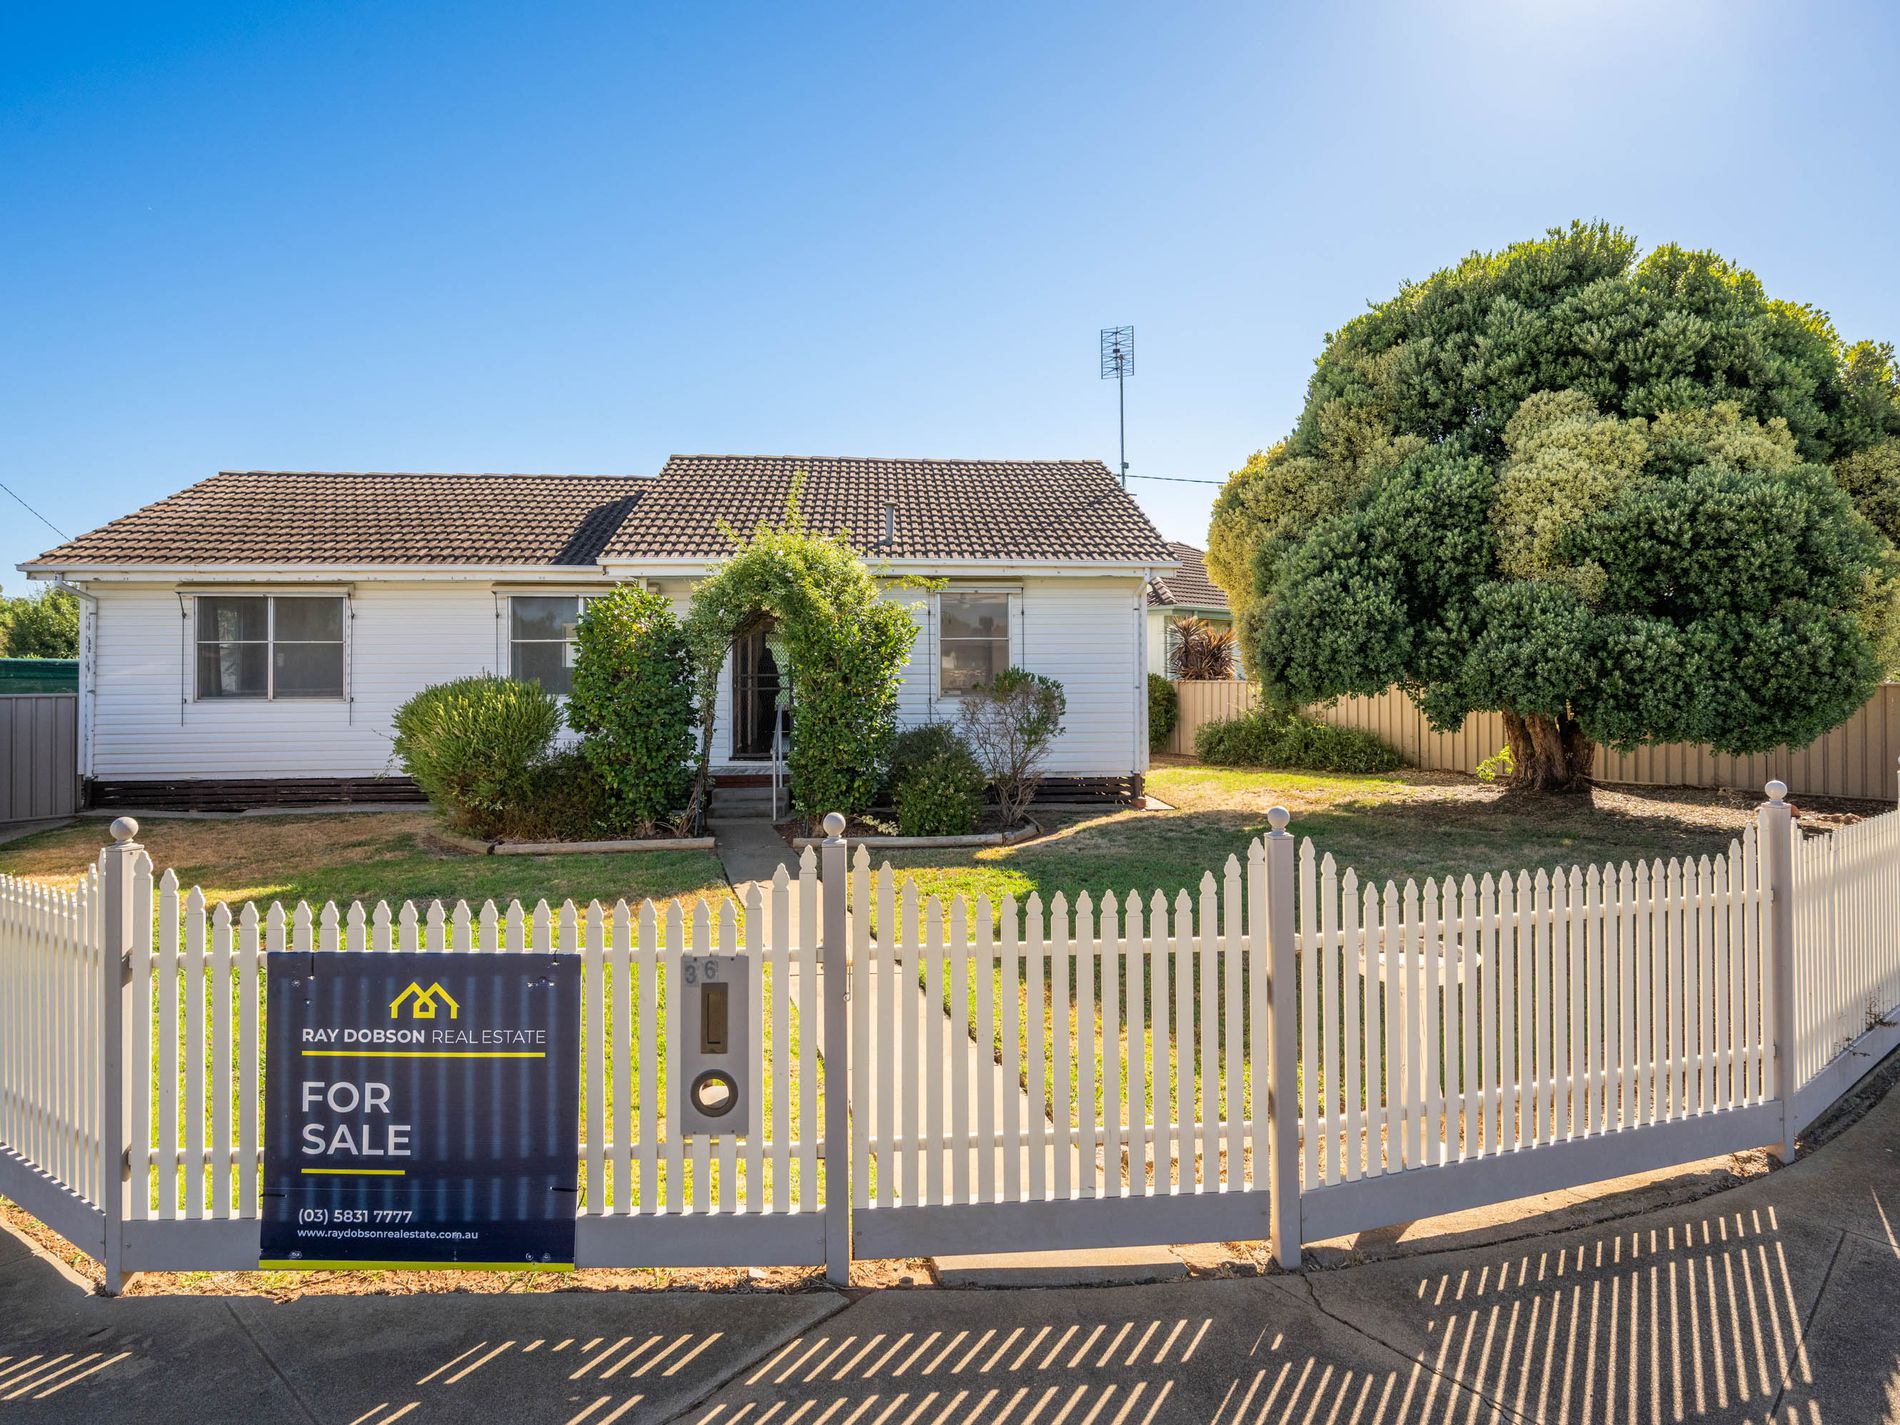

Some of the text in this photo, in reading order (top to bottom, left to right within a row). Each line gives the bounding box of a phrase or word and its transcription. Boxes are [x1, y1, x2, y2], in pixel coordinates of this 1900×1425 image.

[302, 1028, 546, 1044] RAY DOBSON REAL ESTATE
[302, 1081, 391, 1113] FOR
[301, 1123, 411, 1156] SALE
[298, 1208, 412, 1225] (03) 5831 7777
[297, 1228, 478, 1240] www.raydobsonrealestate.com.au
